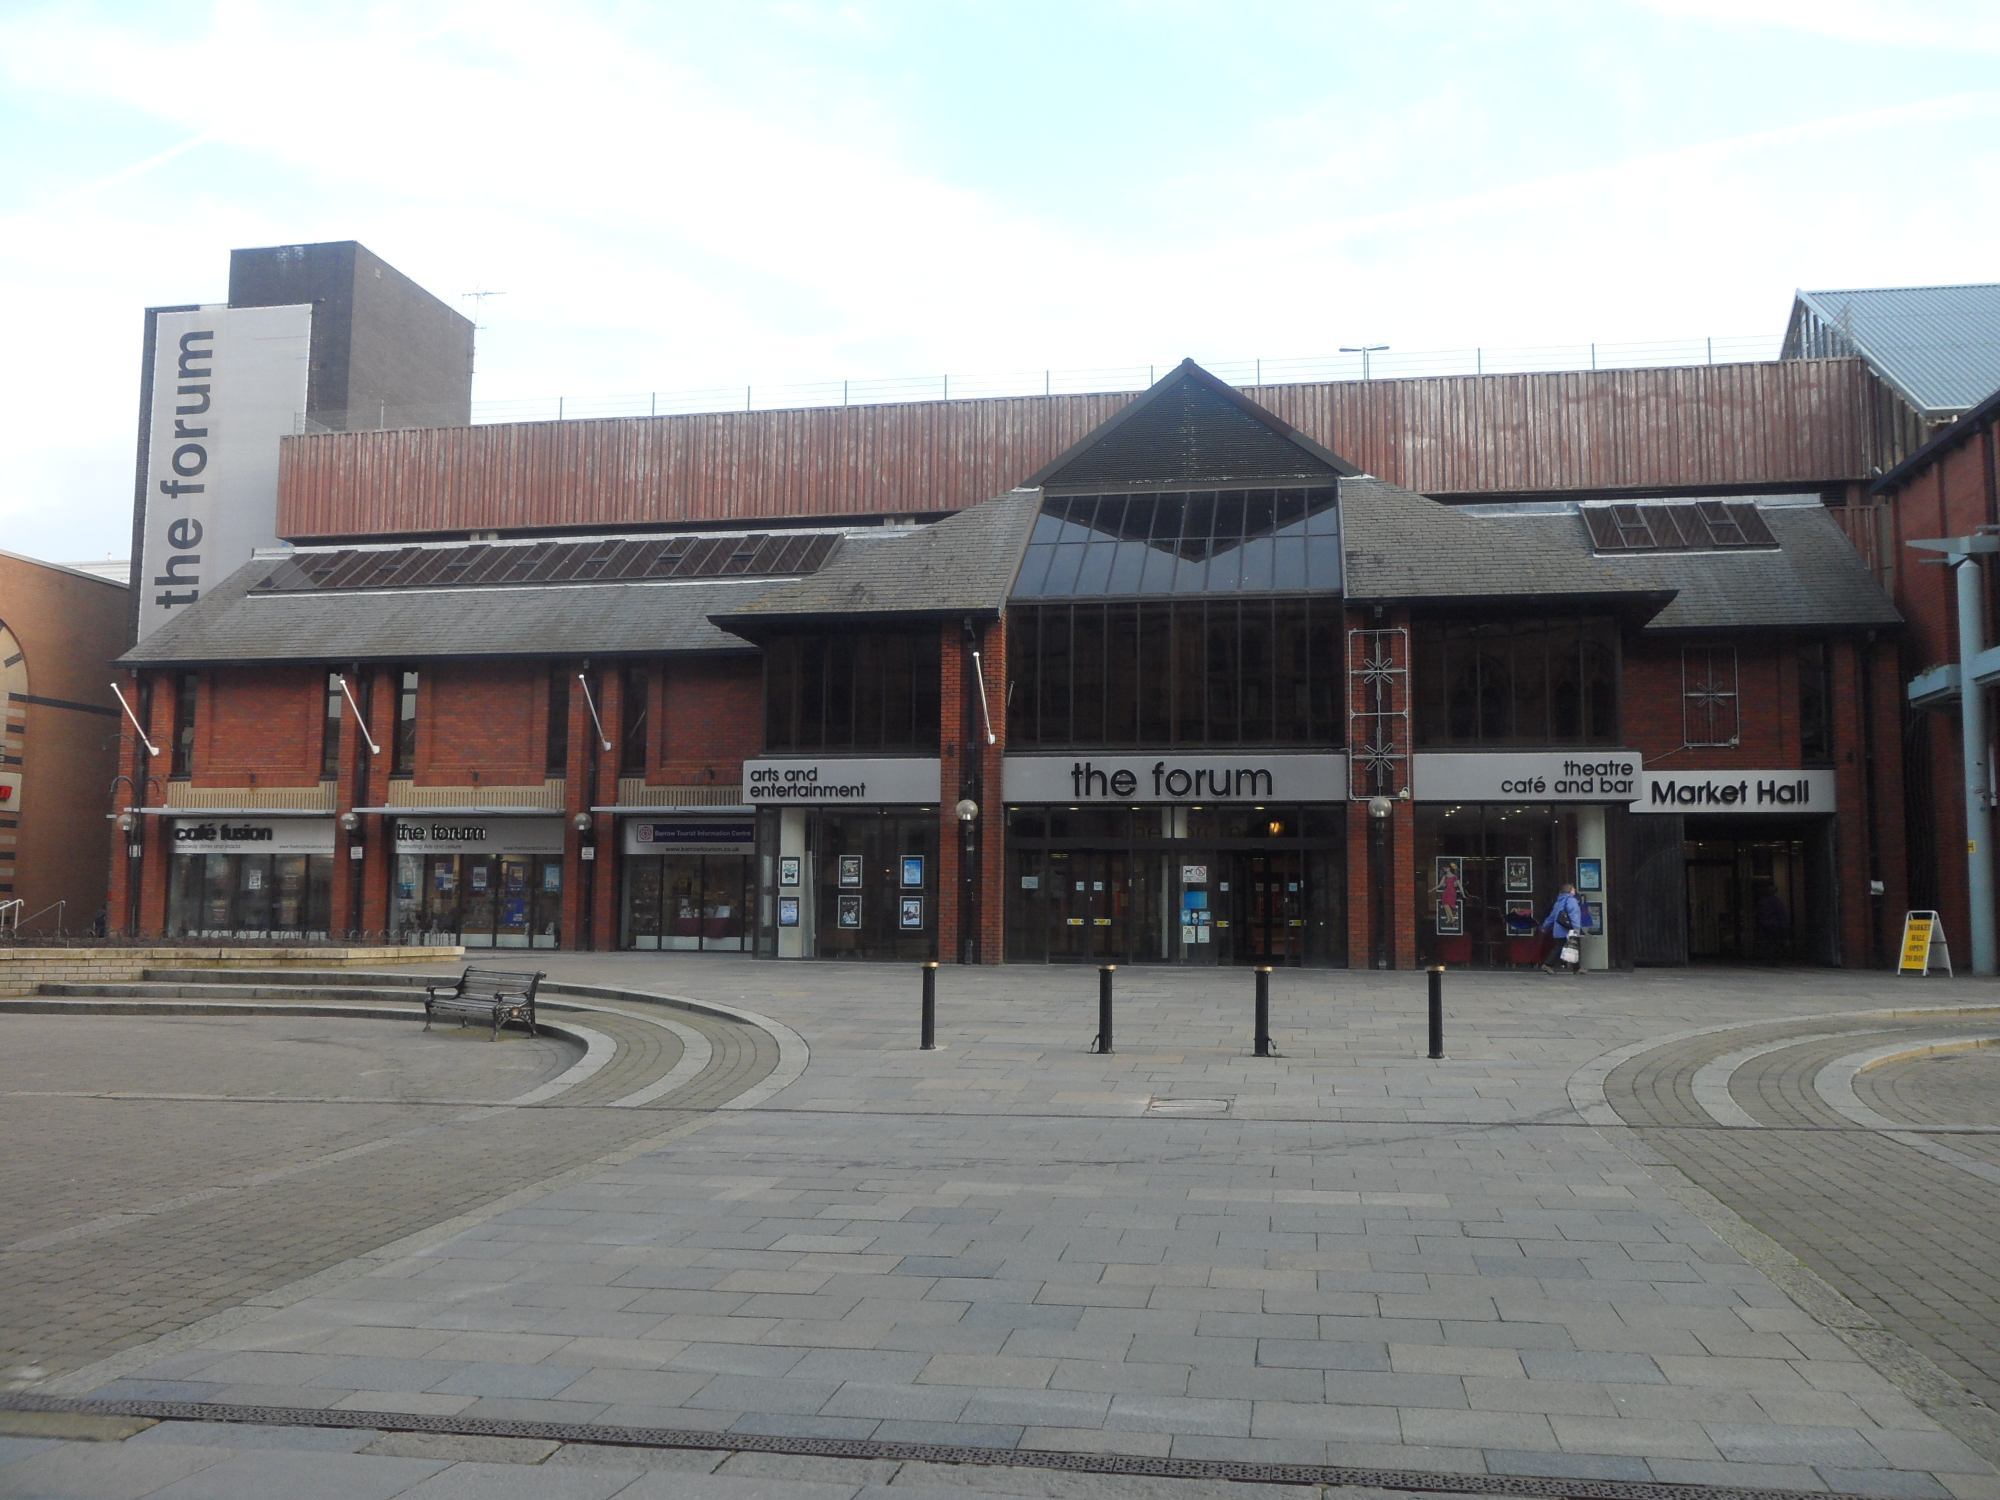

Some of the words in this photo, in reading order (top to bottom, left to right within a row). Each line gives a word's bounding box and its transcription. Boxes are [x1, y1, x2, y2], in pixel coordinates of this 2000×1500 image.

[160, 330, 214, 499] forum
[154, 517, 203, 609] the
[750, 768, 779, 782] arts
[784, 767, 818, 782] and
[1563, 760, 1633, 777] theatre
[1070, 762, 1137, 797] the
[1152, 761, 1273, 797] forum
[1501, 775, 1546, 794] café
[1554, 777, 1593, 794] and
[1600, 777, 1634, 794] bar
[750, 782, 866, 798] entertainment
[1651, 780, 1748, 805] Market
[1756, 780, 1810, 805] Hall
[175, 823, 217, 841] café
[220, 824, 273, 841] fusion
[396, 824, 427, 841] the
[431, 824, 486, 841] forum
